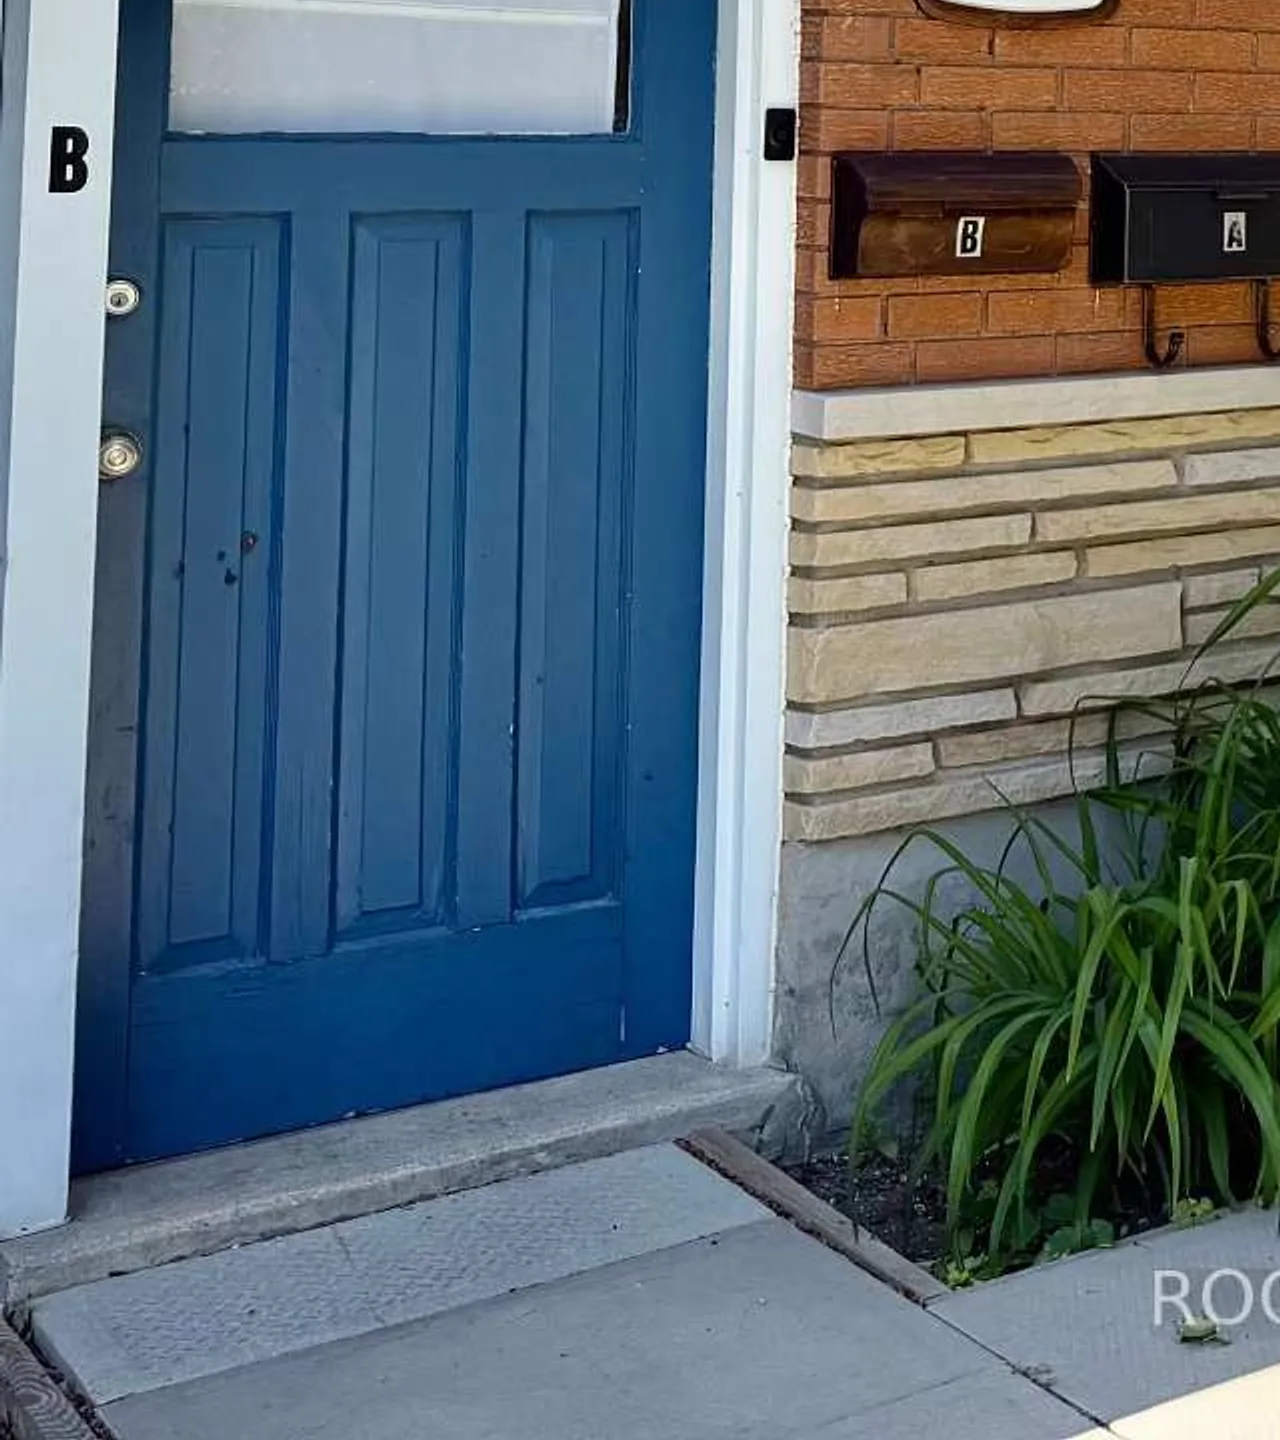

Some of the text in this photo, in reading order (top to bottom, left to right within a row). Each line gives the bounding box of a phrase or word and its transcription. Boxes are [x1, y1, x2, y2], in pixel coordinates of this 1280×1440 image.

[49, 127, 89, 193] B
[960, 220, 979, 254] B
[1227, 220, 1243, 248] A
